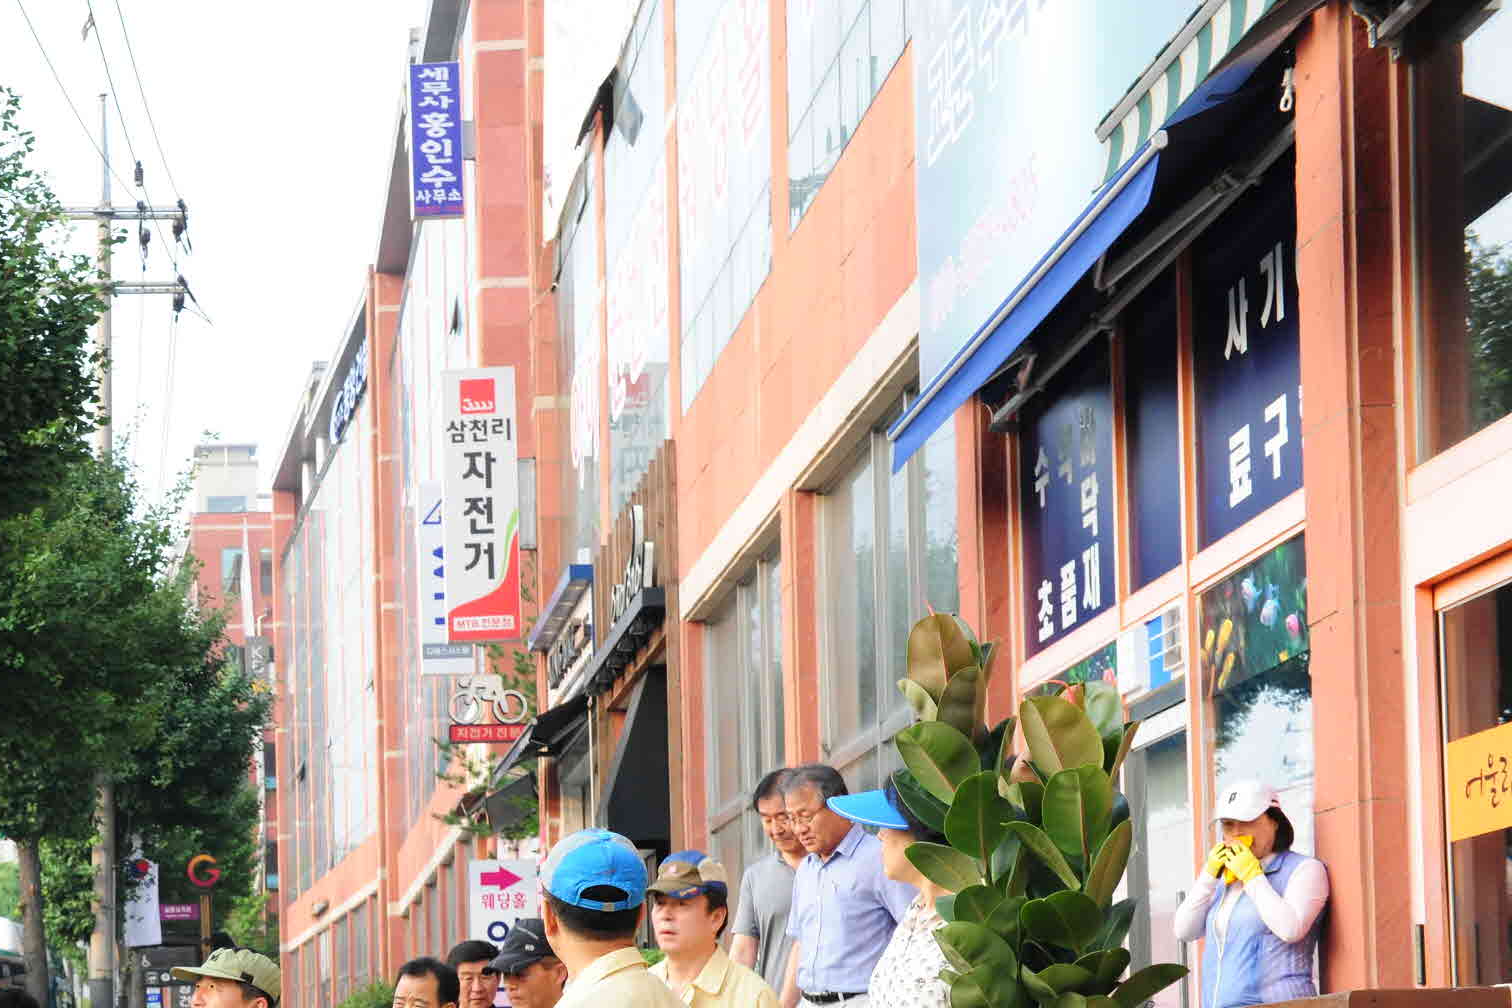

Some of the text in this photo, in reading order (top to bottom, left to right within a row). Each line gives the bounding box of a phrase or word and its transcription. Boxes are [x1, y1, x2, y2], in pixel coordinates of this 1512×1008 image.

[418, 66, 455, 109] 세무사
[416, 189, 462, 205] 사무소
[446, 418, 512, 444] 삼천리
[462, 452, 497, 580] 자전거
[481, 893, 527, 910] 웨딩홀
